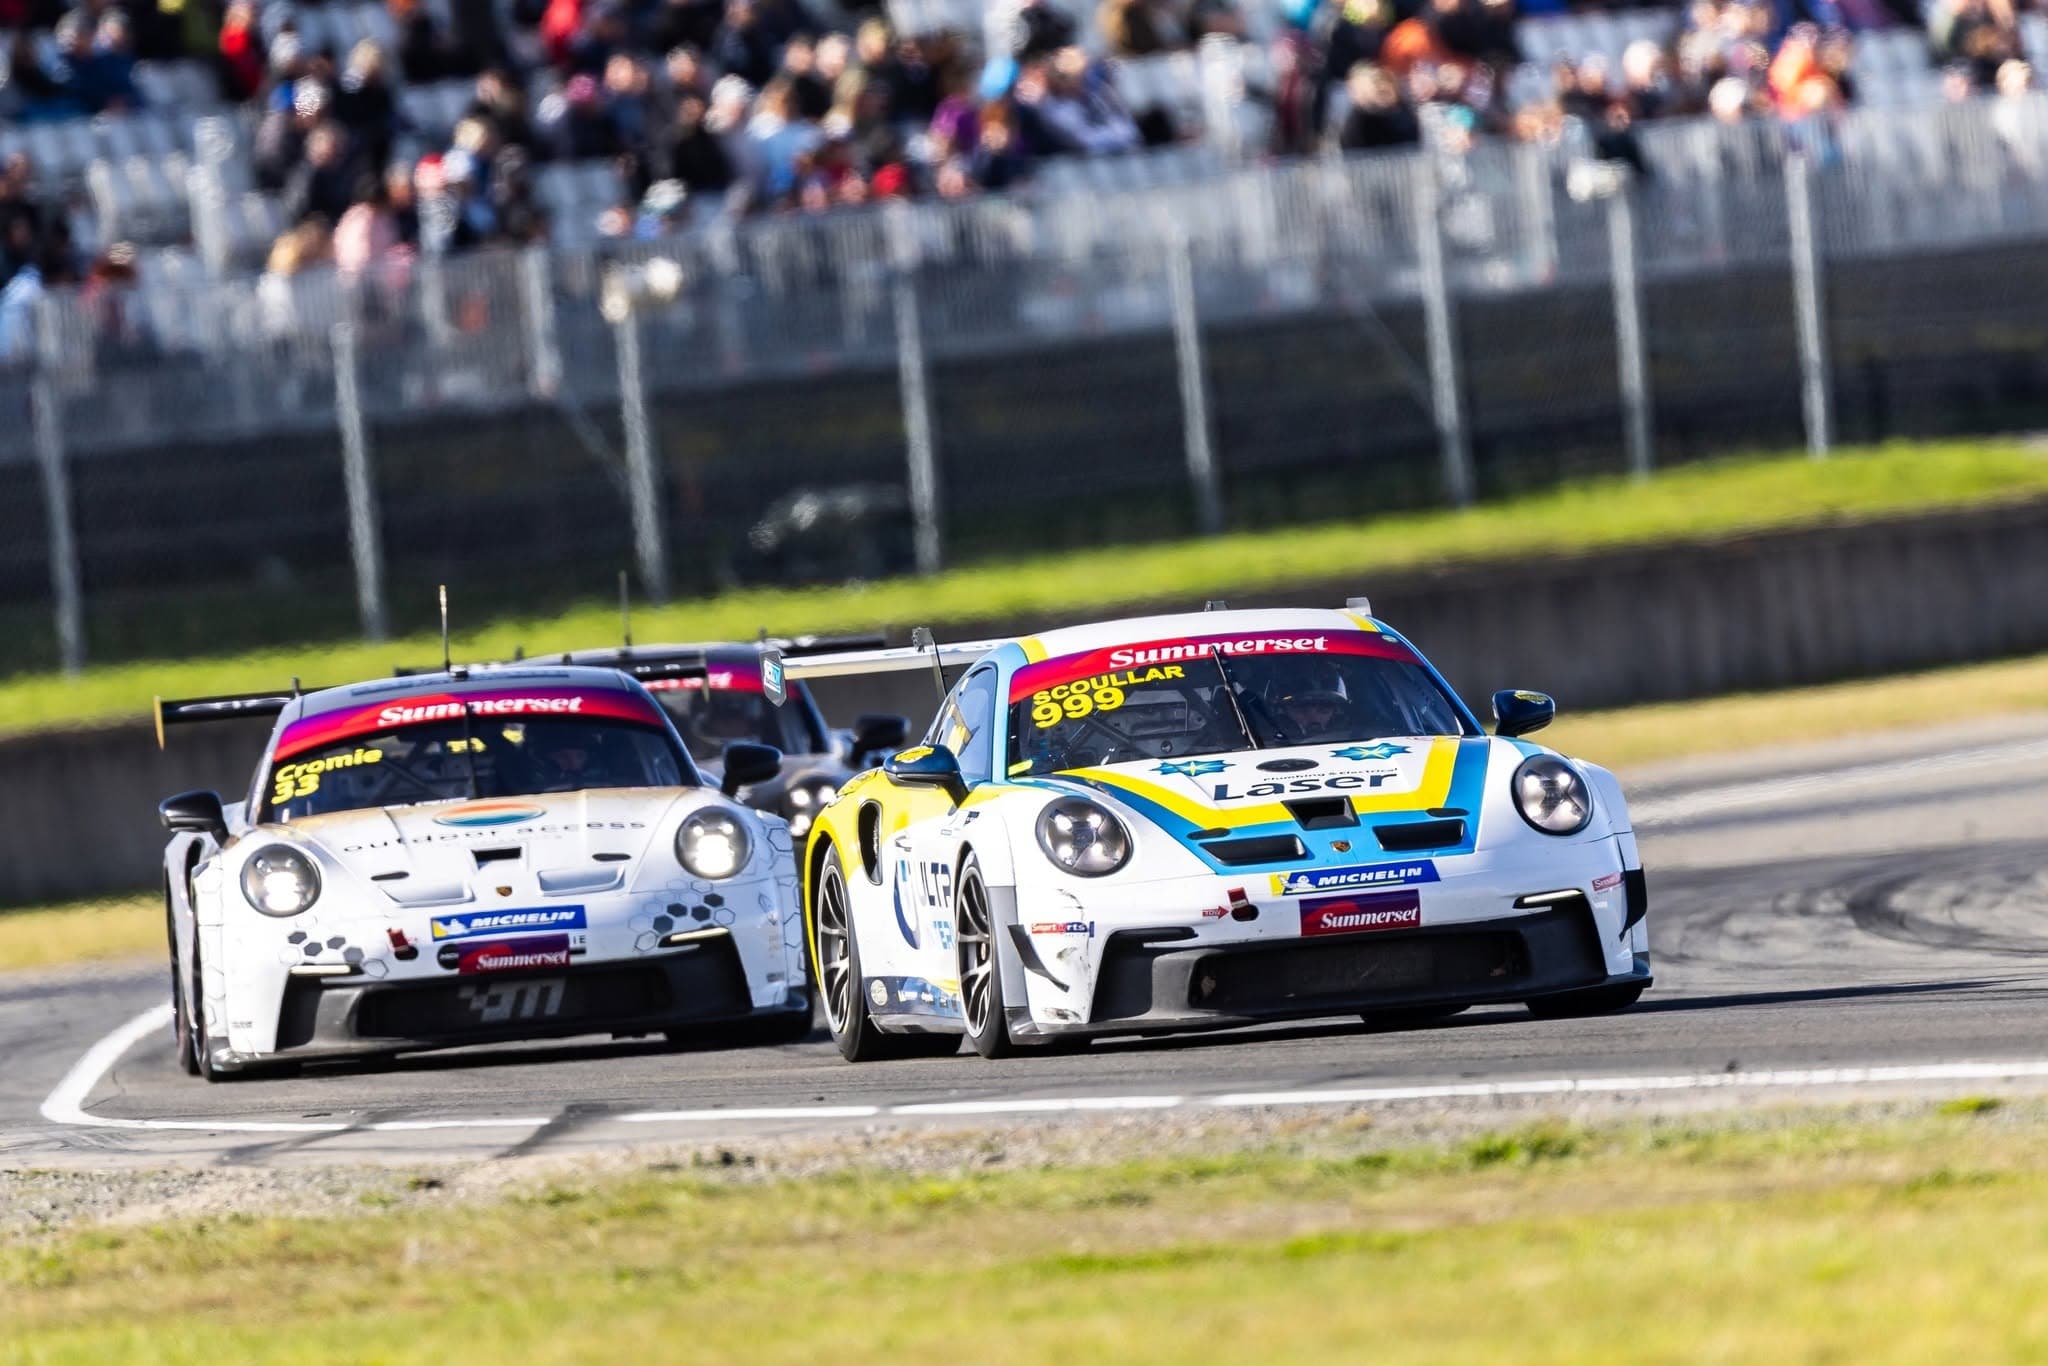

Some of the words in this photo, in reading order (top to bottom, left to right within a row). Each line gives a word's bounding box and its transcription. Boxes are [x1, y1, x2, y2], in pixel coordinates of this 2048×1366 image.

[1109, 636, 1328, 668] Summerset
[1032, 665, 1185, 706] SCOULLAR
[377, 696, 583, 726] Summerset
[1031, 686, 1126, 729] 999
[275, 748, 383, 783] Cromie
[271, 773, 321, 805] 33
[1214, 773, 1397, 801] Laser
[344, 830, 497, 852] outdoor
[517, 821, 646, 833] access
[1318, 867, 1422, 887] MICHELIN
[469, 911, 576, 929] MICHELIN
[1320, 906, 1418, 929] Summerset
[476, 949, 569, 970] Summerset
